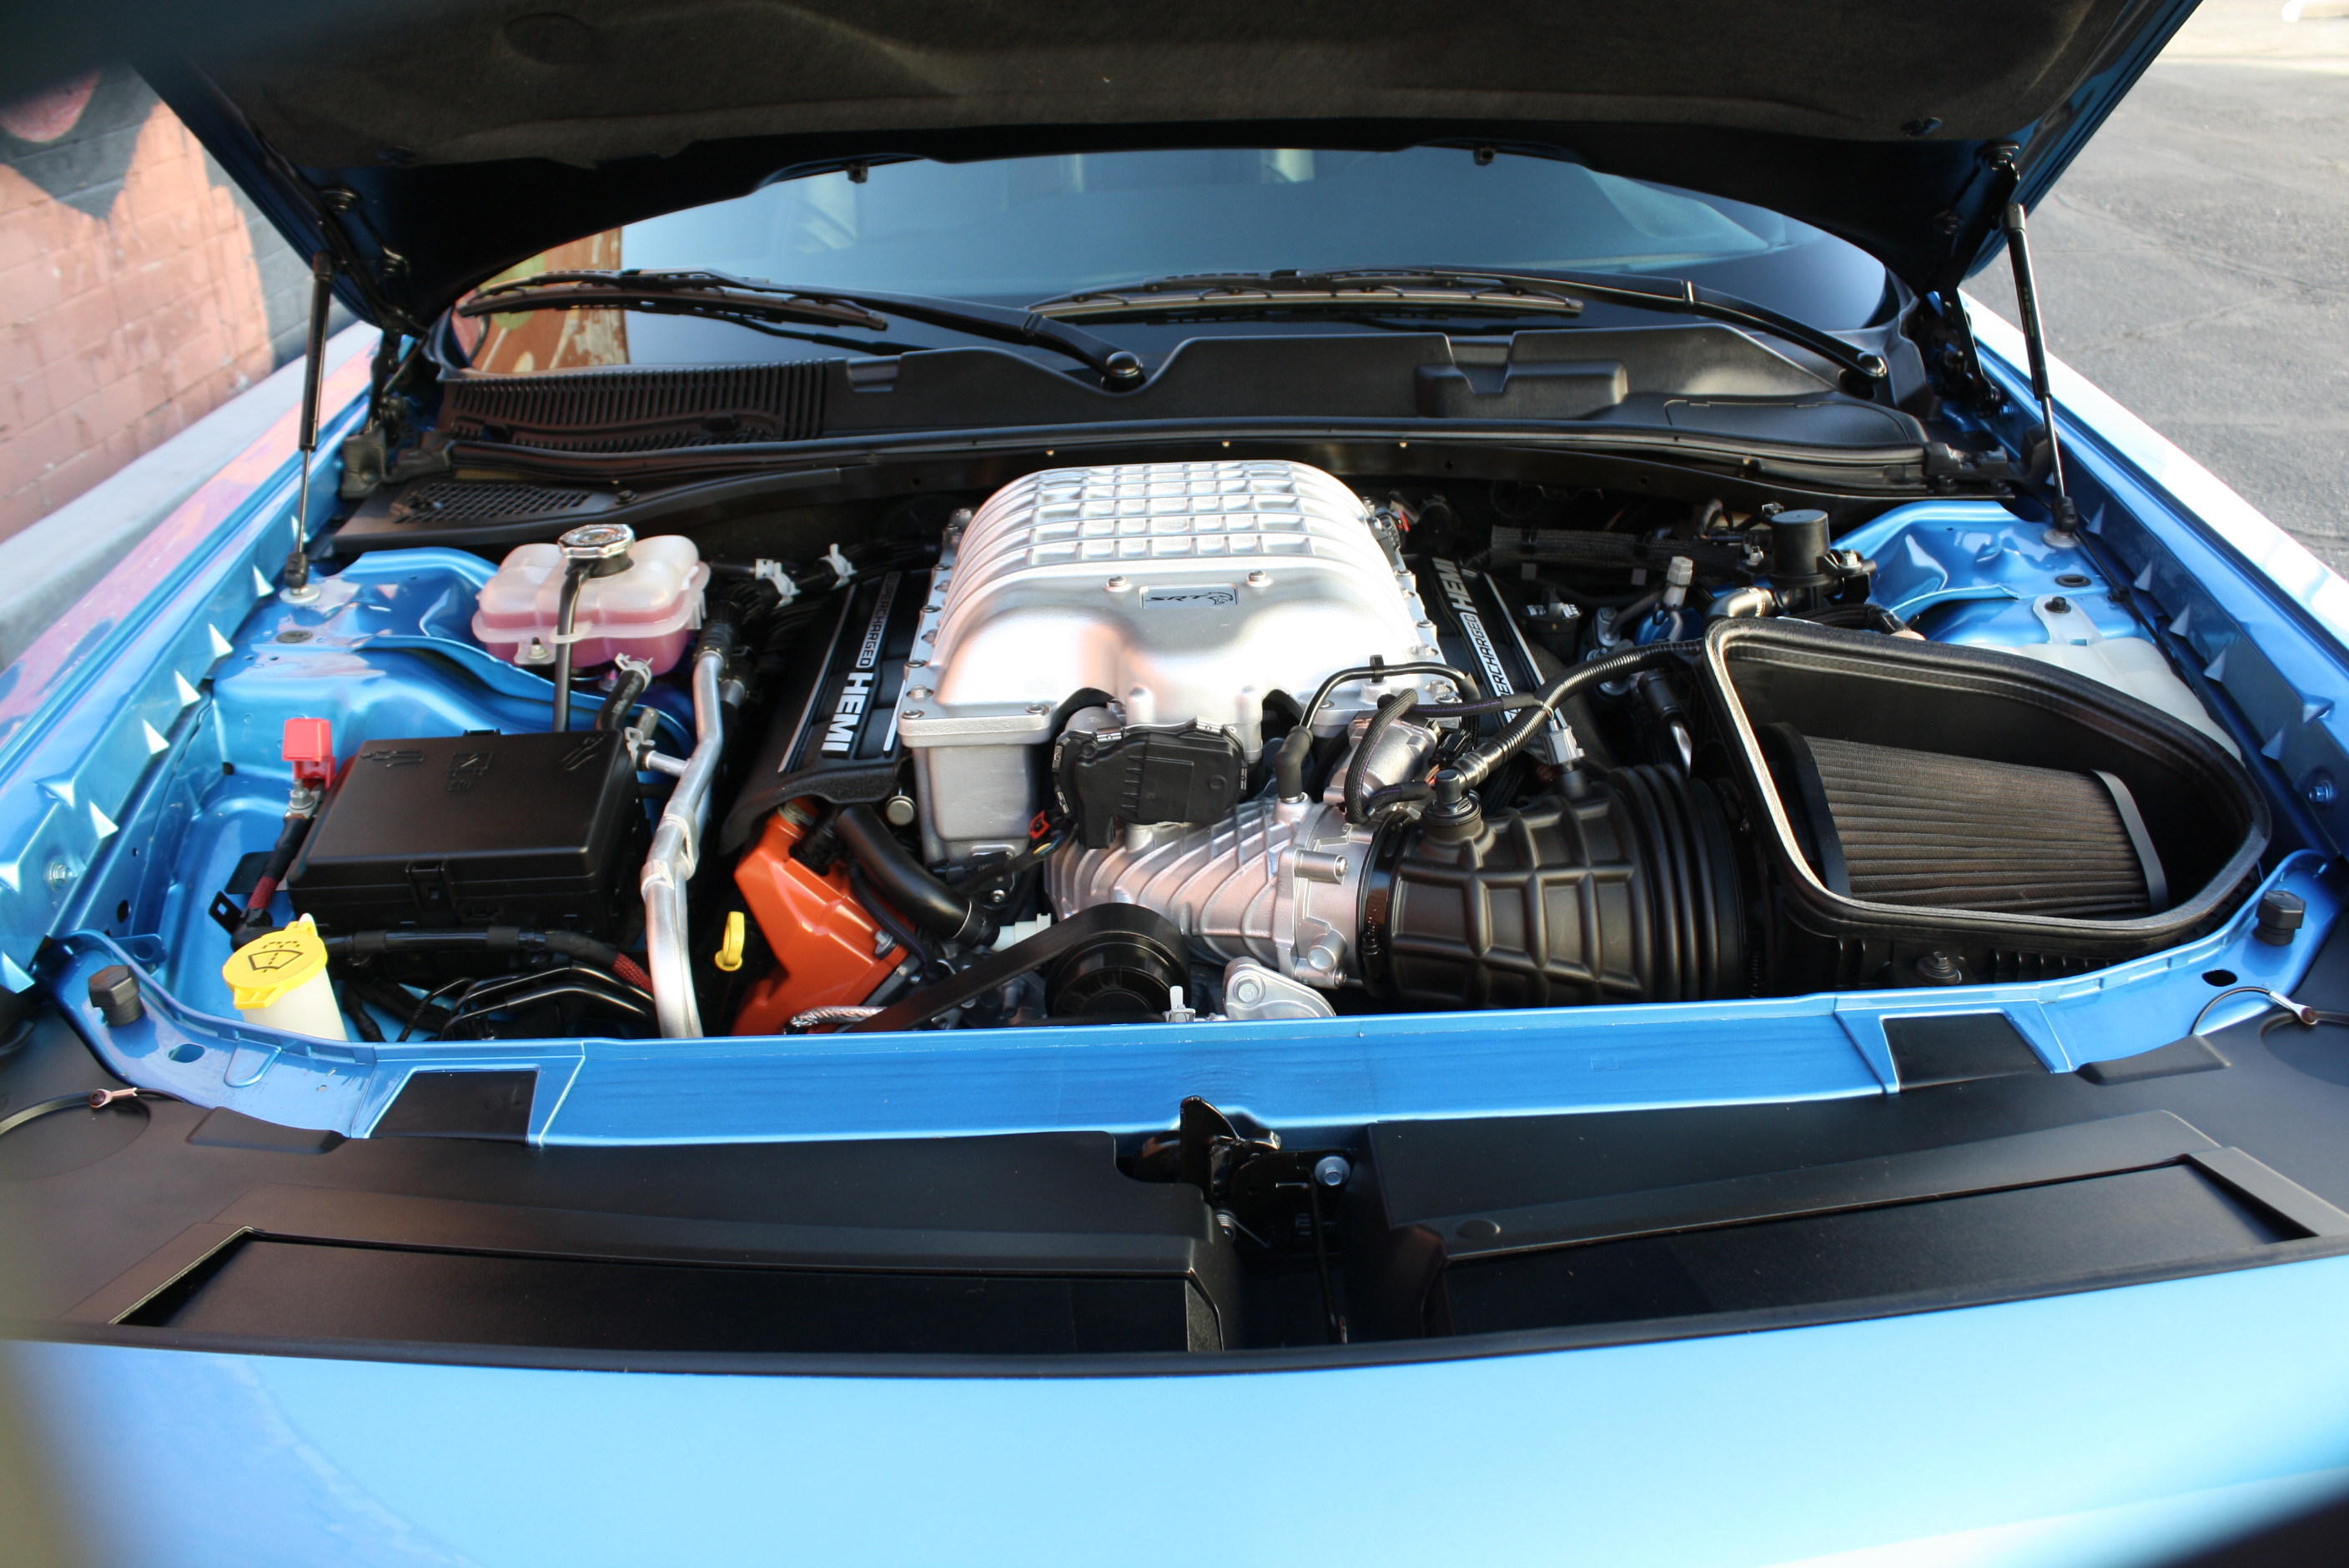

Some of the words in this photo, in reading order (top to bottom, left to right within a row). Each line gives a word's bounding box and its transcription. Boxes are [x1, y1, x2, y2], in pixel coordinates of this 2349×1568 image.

[860, 572, 898, 666] SUPERCHARGED
[1431, 557, 1477, 614] HEMI
[1463, 614, 1520, 721] ERCHARGED
[821, 672, 874, 751] HEMI
